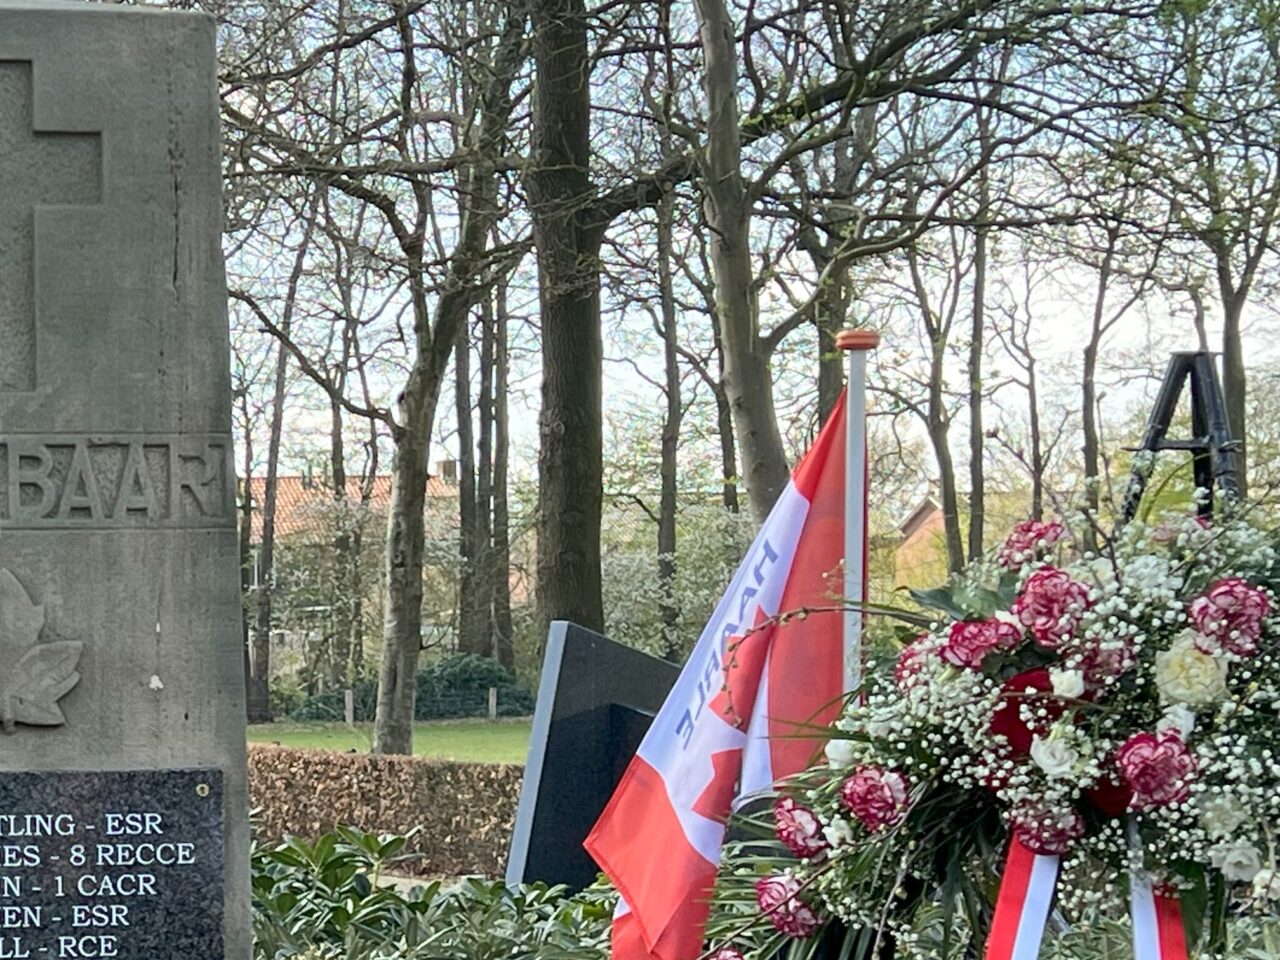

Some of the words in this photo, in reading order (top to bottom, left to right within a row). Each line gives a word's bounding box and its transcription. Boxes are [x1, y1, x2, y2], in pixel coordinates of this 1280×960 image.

[105, 812, 164, 835] ESR
[69, 844, 86, 866] 8
[96, 842, 196, 866] RECCE
[54, 875, 65, 897] 1
[77, 873, 157, 897] CACR
[71, 904, 130, 927] ESR
[58, 935, 118, 958] RCE
